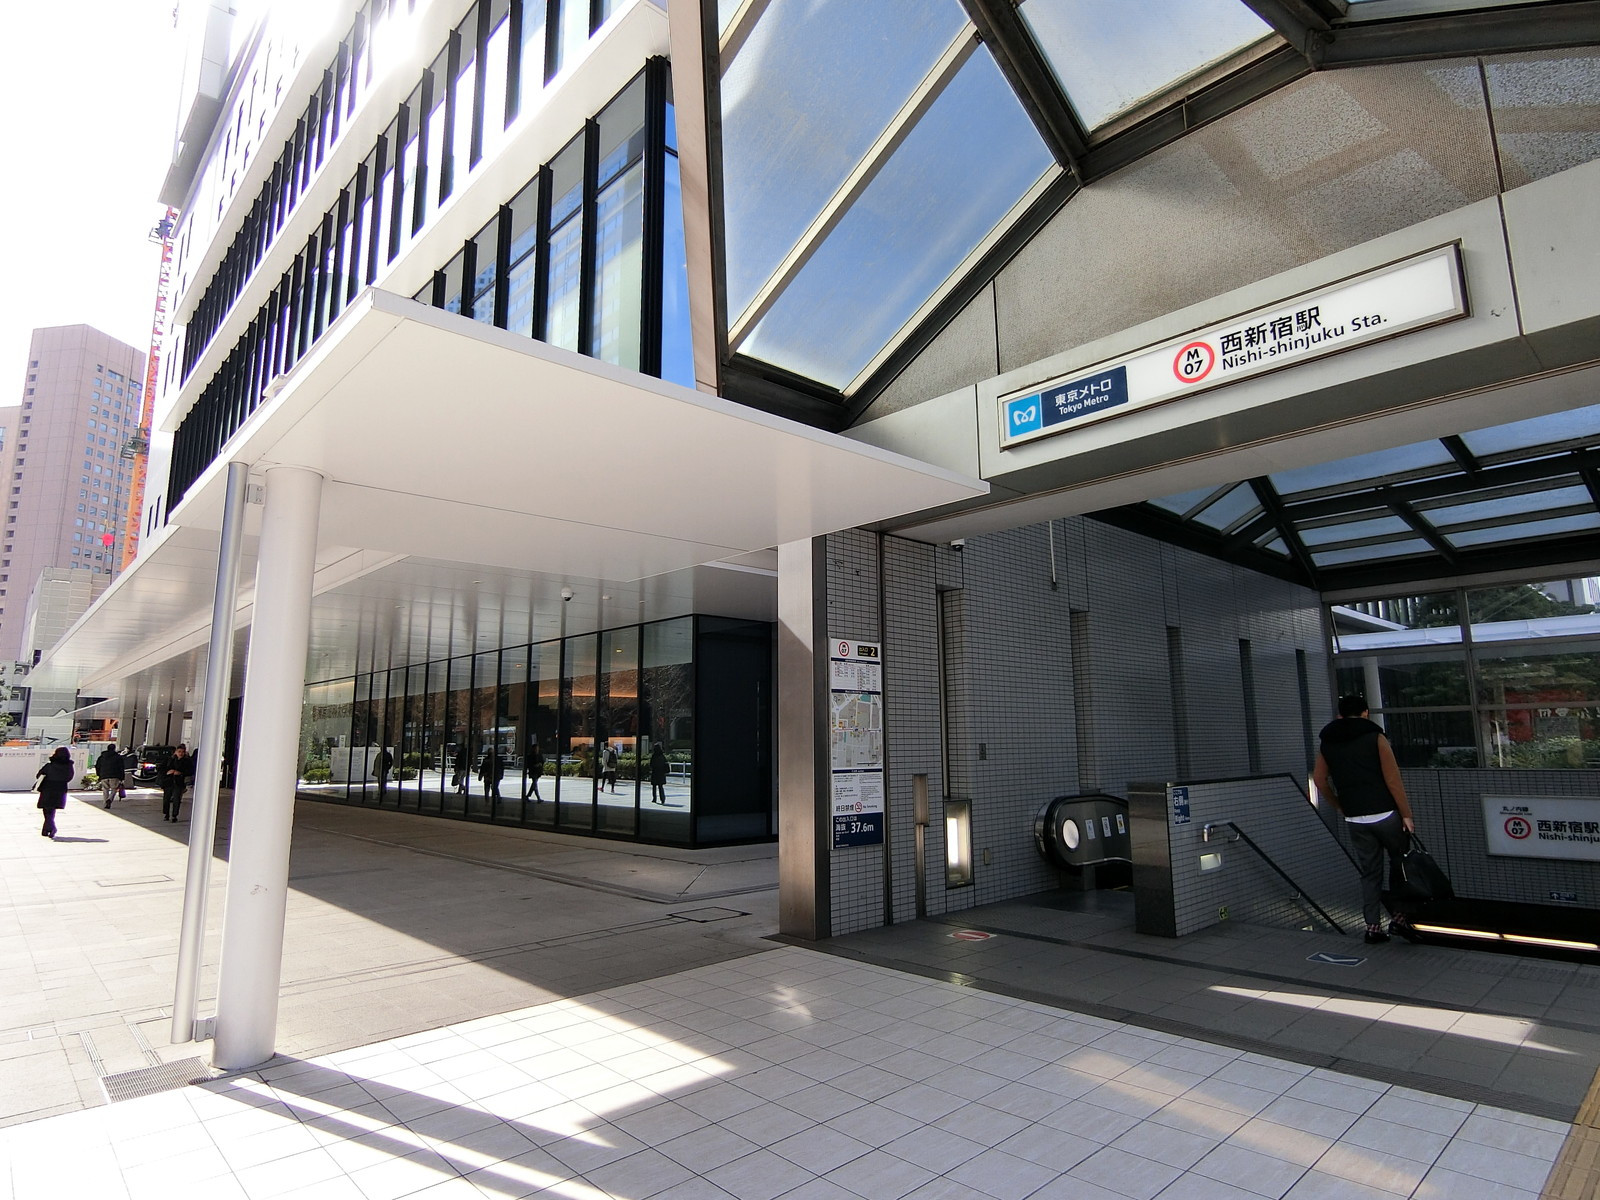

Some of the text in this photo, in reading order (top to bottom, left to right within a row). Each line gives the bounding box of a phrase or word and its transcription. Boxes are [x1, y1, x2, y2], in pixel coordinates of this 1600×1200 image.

[1220, 306, 1322, 356] 西新宿駅
[1222, 314, 1388, 371] Nishi-shinjuku Sta.
[1186, 348, 1200, 362] M
[1184, 359, 1203, 376] 07
[1054, 378, 1112, 407] 東京メトロ
[1059, 394, 1109, 415] Tokyo Metro
[870, 647, 876, 656] 2
[850, 822, 874, 834] 37.6m
[1511, 827, 1525, 835] 07
[1536, 819, 1600, 834] 西新宿駅
